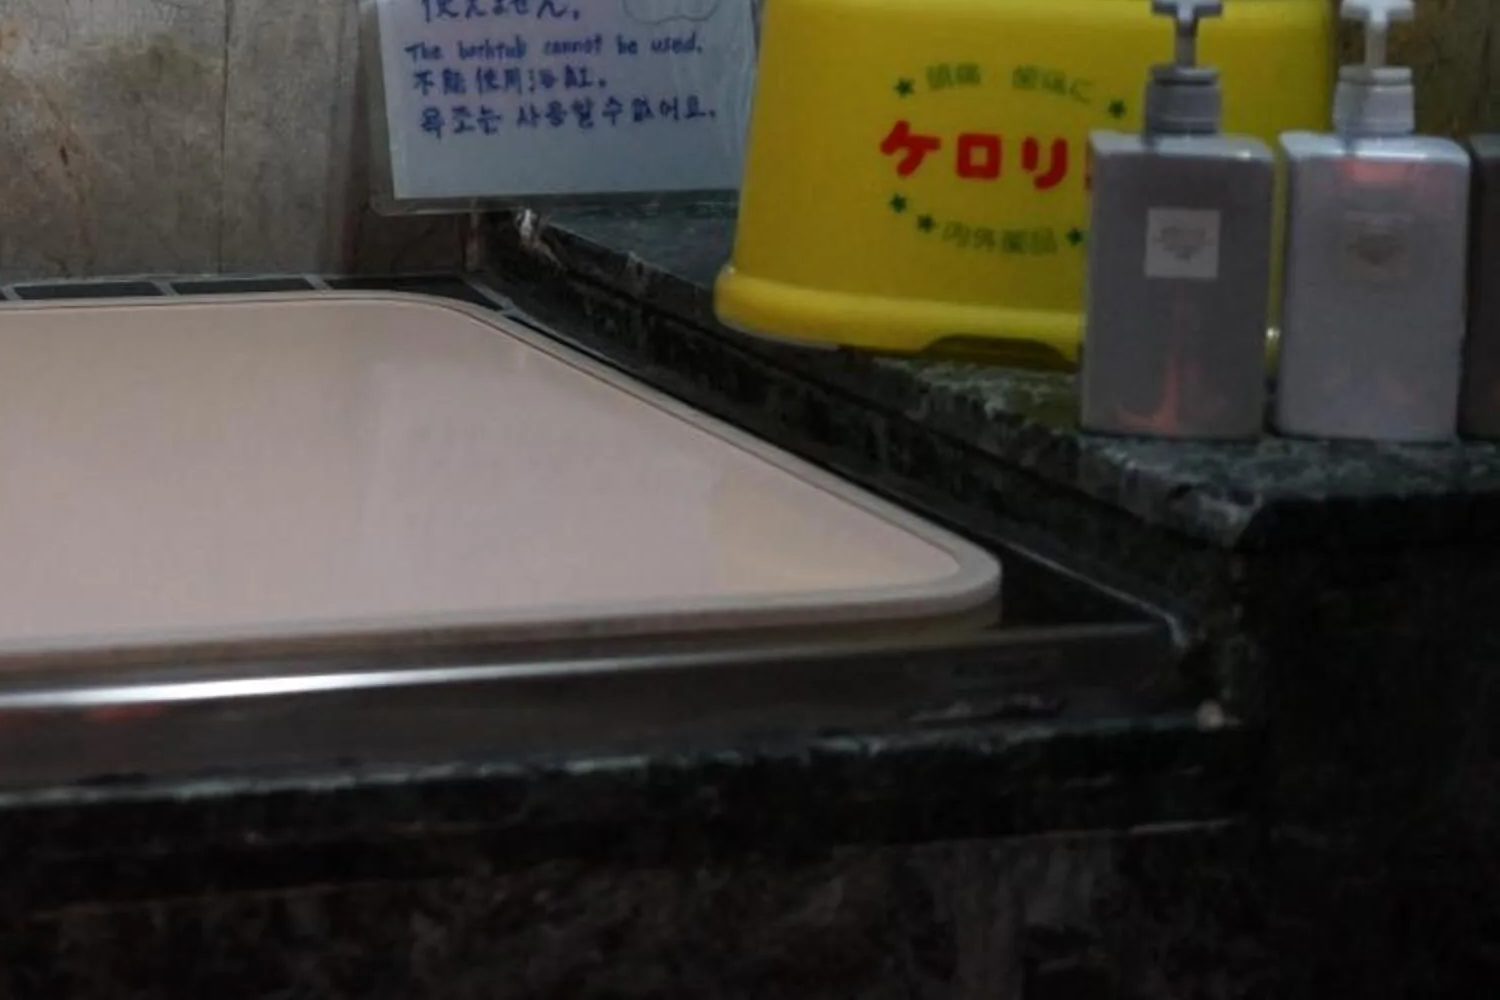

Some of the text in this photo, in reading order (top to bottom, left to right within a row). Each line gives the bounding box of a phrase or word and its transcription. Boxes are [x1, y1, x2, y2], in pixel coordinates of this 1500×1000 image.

[405, 31, 704, 60] The bathtub cannot be used.
[420, 105, 503, 140] 욕조는
[879, 118, 1093, 192] ケロリ
